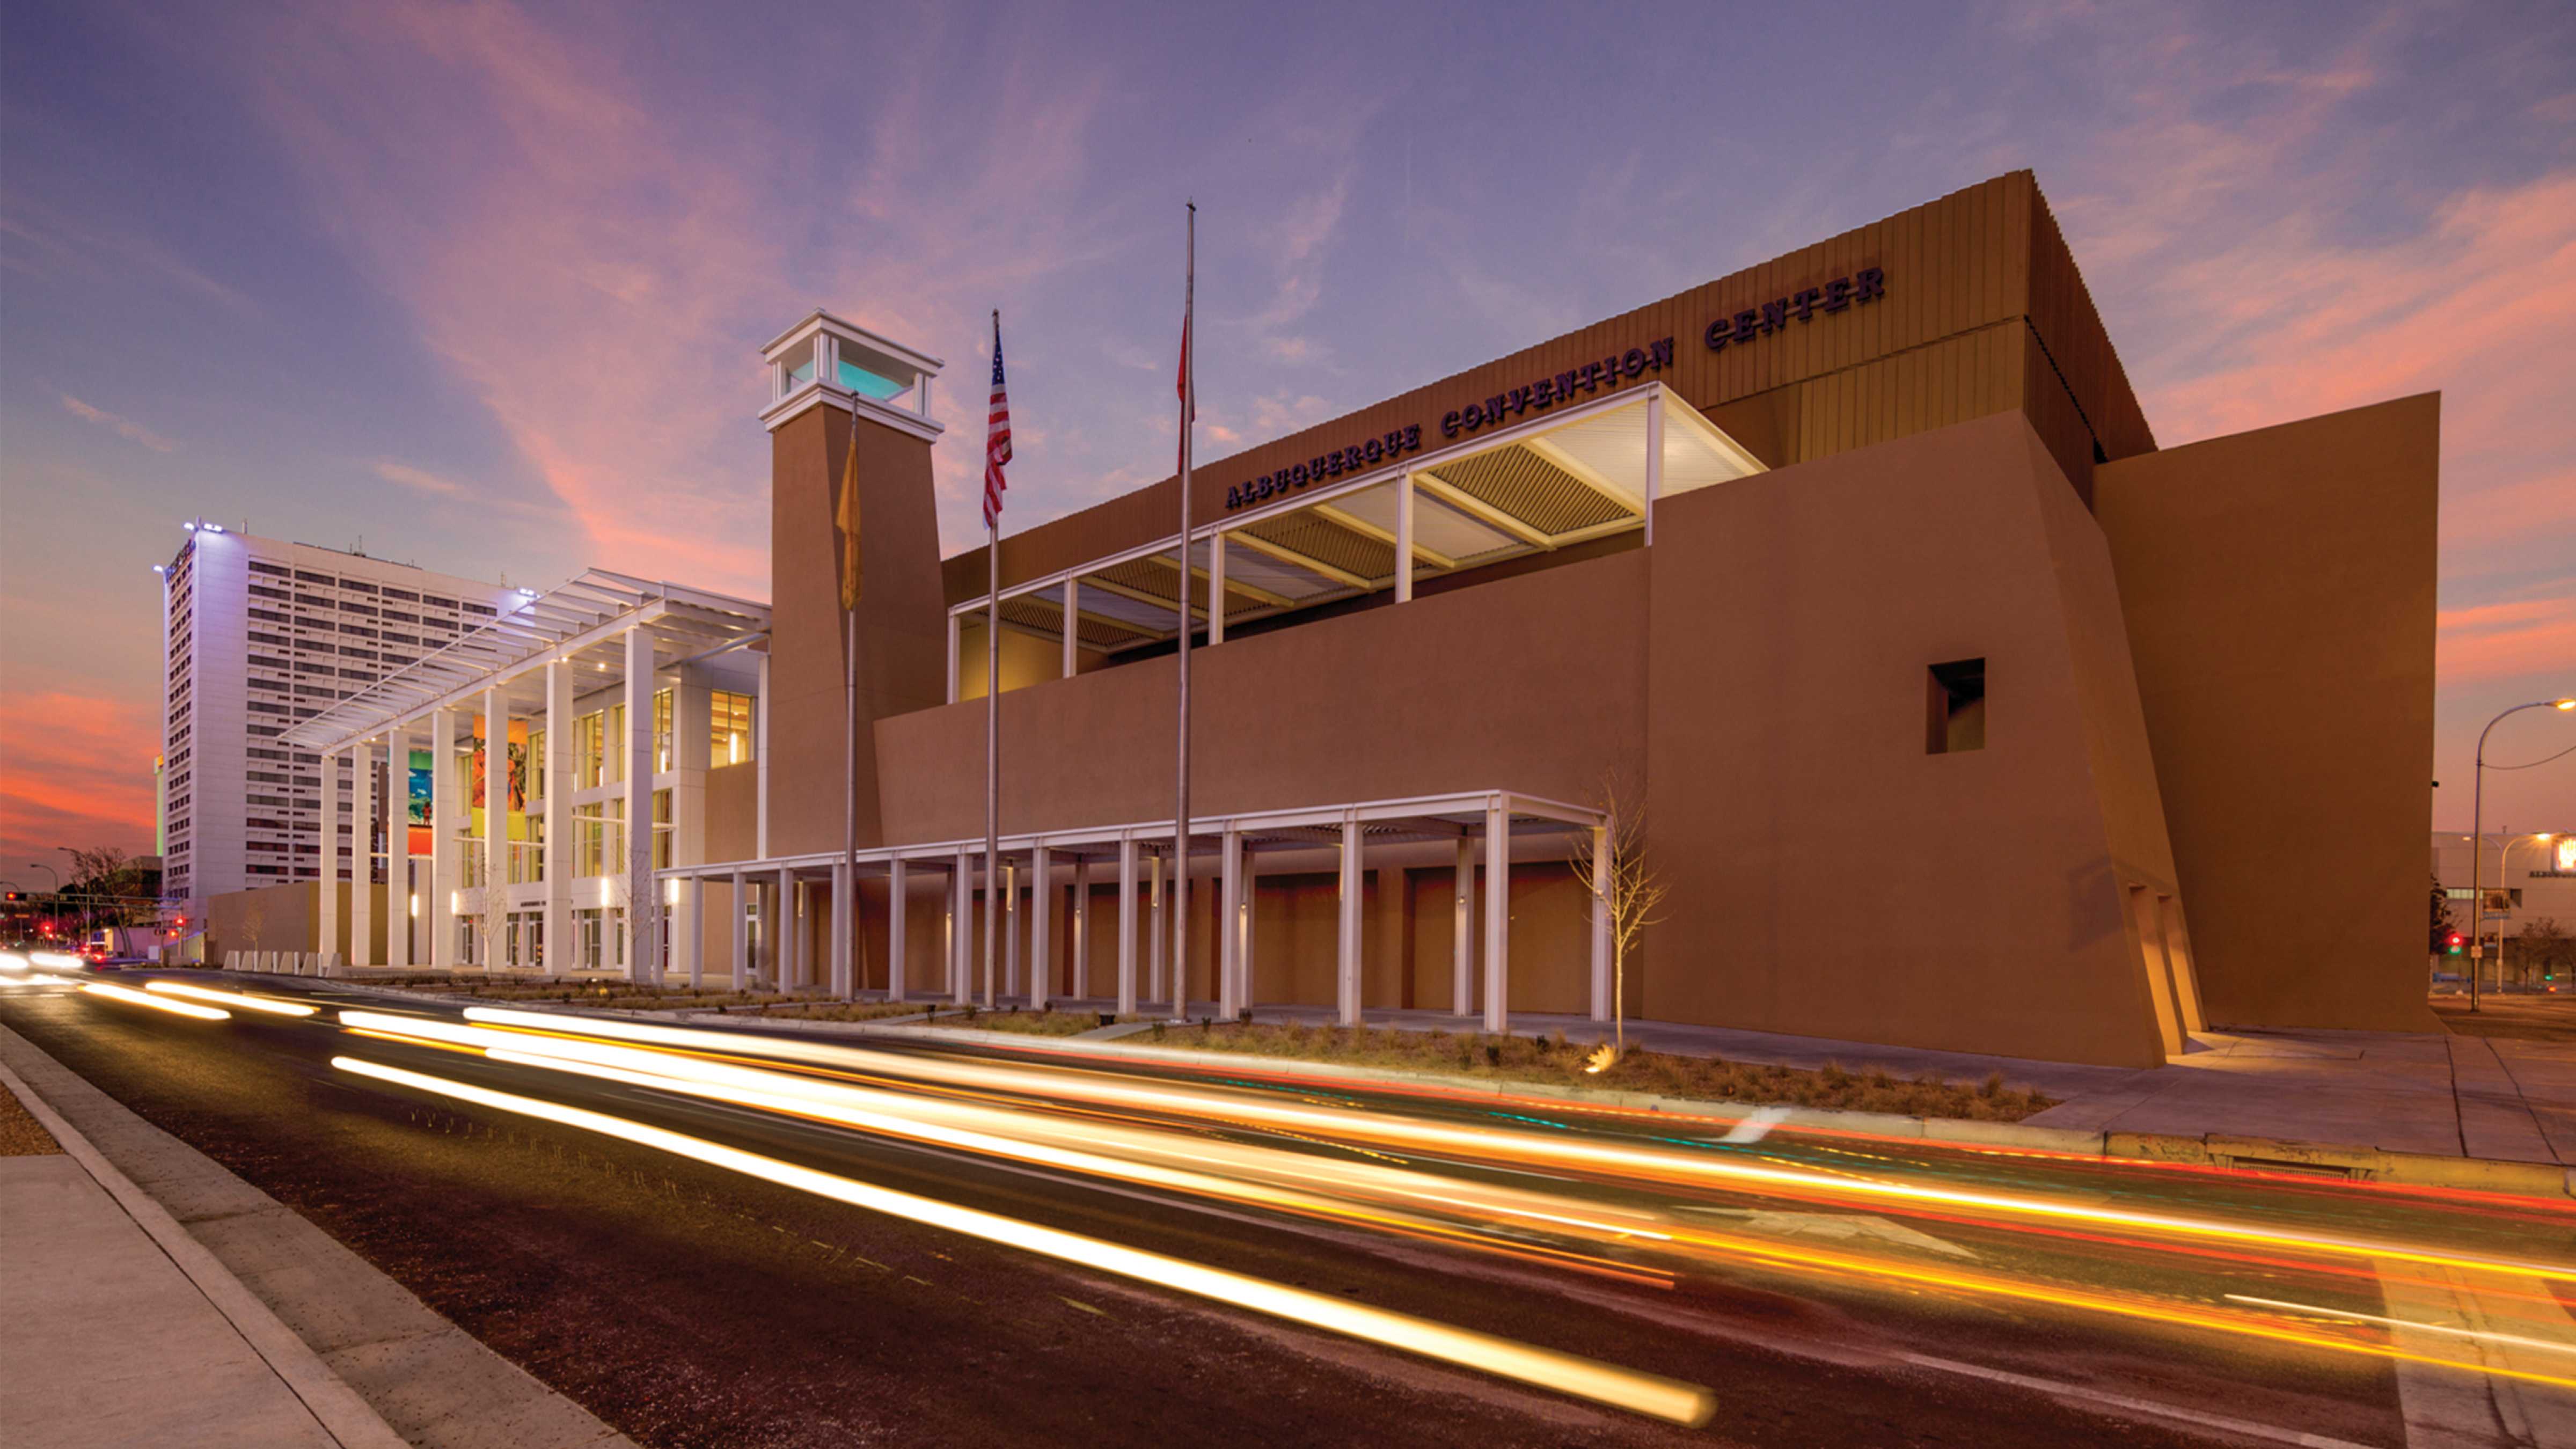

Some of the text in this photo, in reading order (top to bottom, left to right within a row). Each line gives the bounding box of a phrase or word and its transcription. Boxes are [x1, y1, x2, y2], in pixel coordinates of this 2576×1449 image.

[1226, 267, 1884, 509] ALBUQUERQUE CONVENTION CENTER
